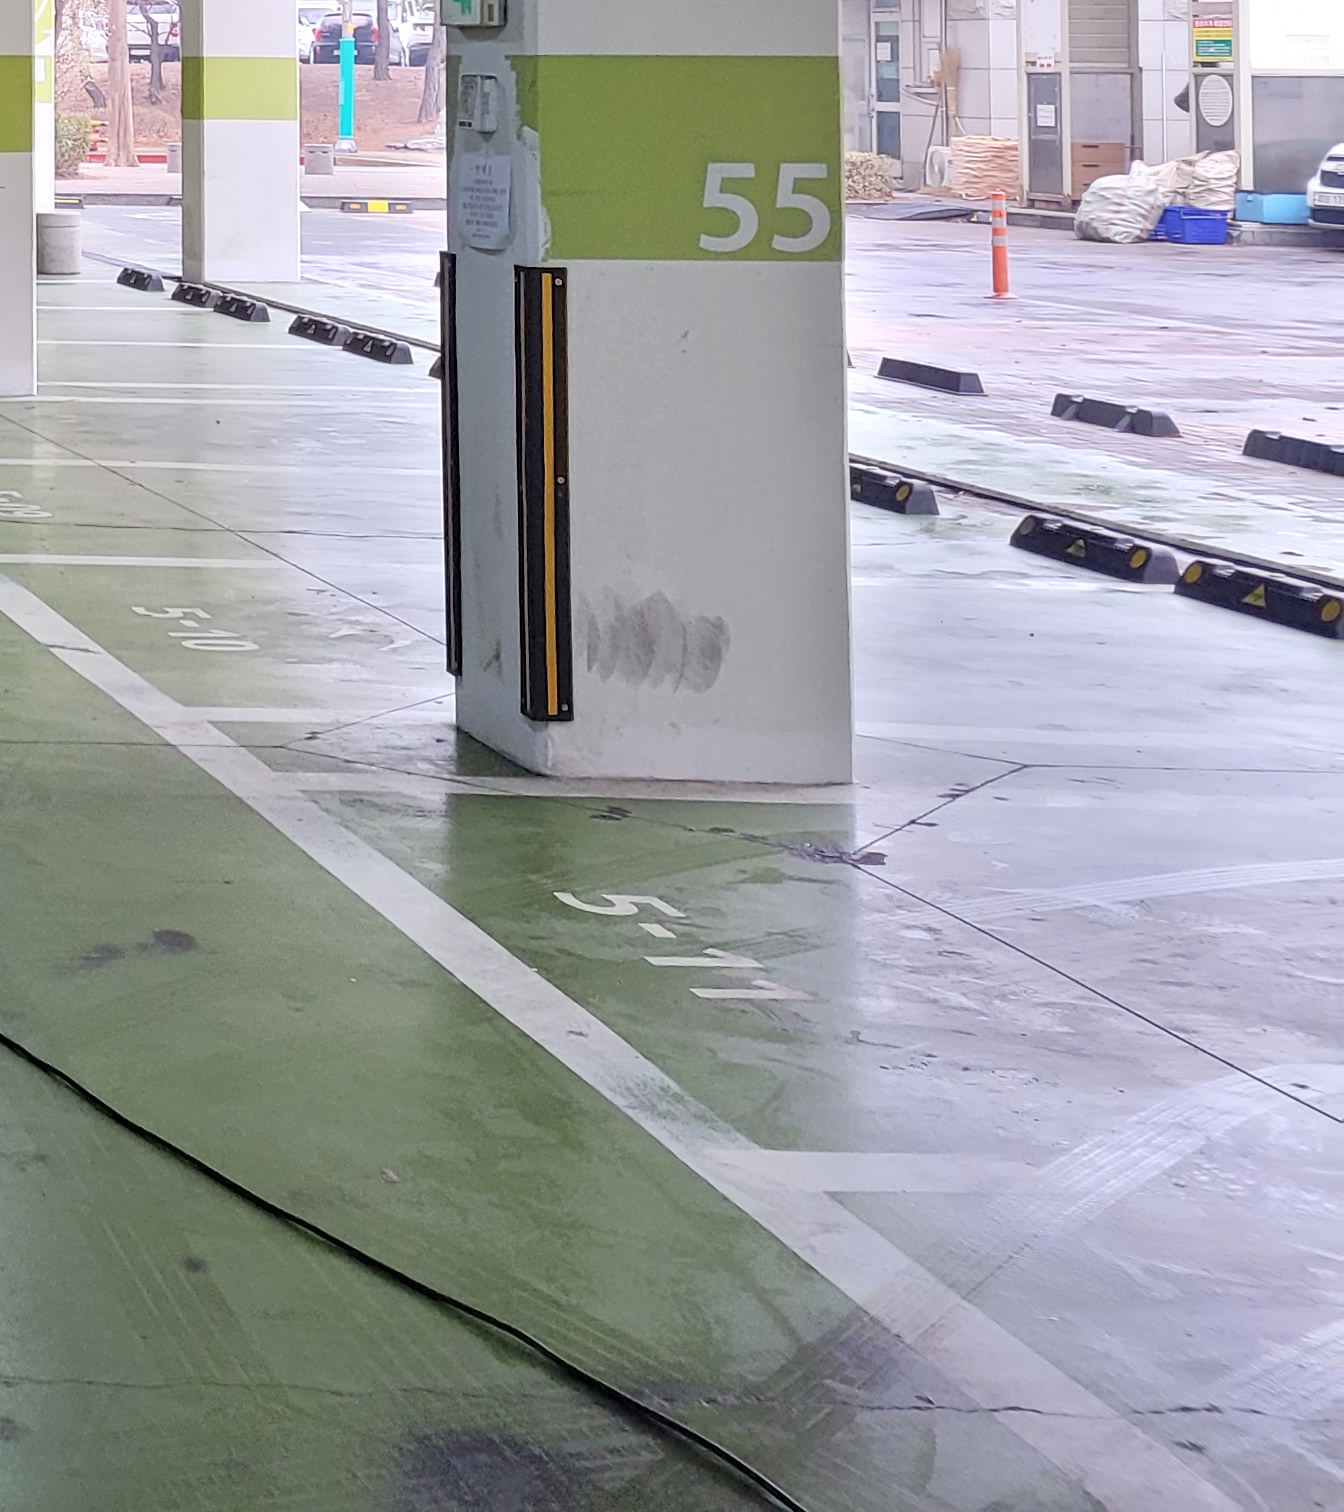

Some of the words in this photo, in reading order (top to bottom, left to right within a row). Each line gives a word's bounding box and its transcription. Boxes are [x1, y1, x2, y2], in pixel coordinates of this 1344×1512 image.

[699, 162, 831, 253] 55
[131, 606, 260, 651] 5-10
[553, 891, 813, 1000] 5-11
